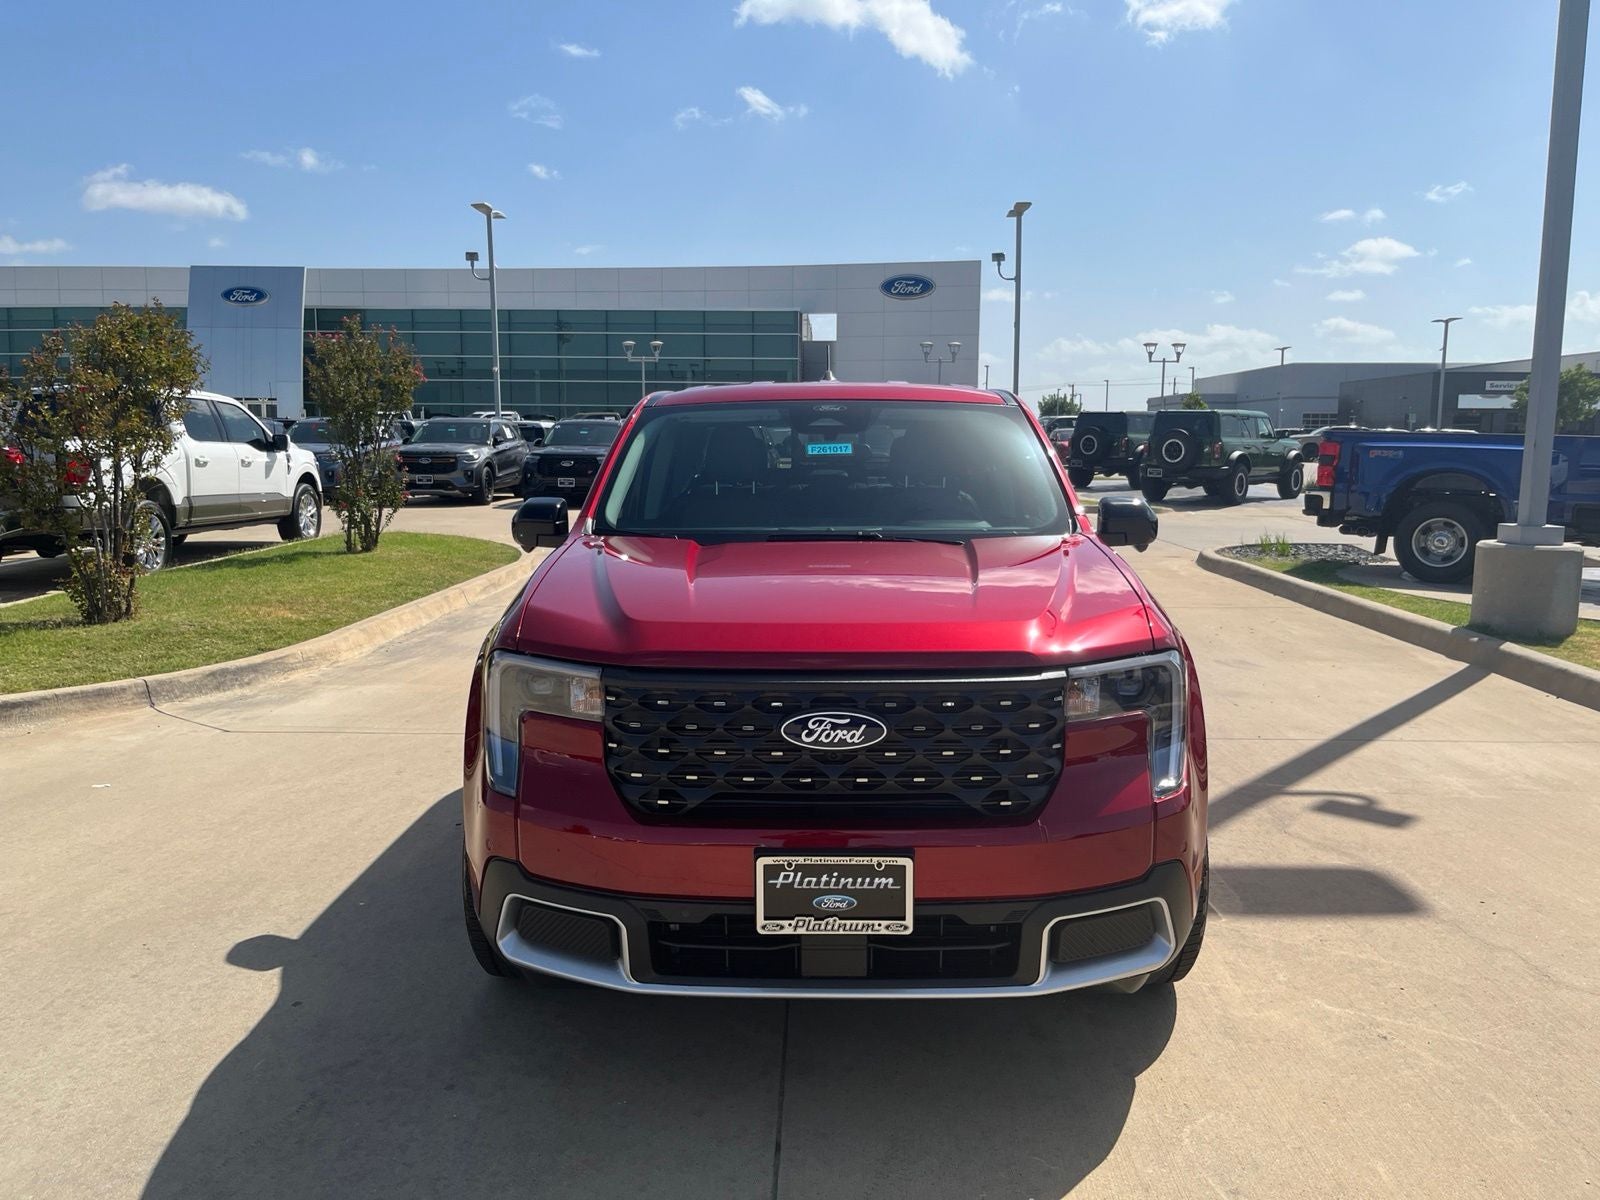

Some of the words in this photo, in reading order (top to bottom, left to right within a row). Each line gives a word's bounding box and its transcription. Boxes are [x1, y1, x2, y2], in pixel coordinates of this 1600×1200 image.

[891, 280, 923, 294] Ford
[230, 290, 257, 301] Ford
[1488, 382, 1515, 390] Servic
[811, 445, 849, 454] F261017
[801, 717, 866, 743] Ford
[767, 872, 901, 889] Platinum
[821, 897, 849, 909] Ford
[793, 919, 881, 932] Platinum
